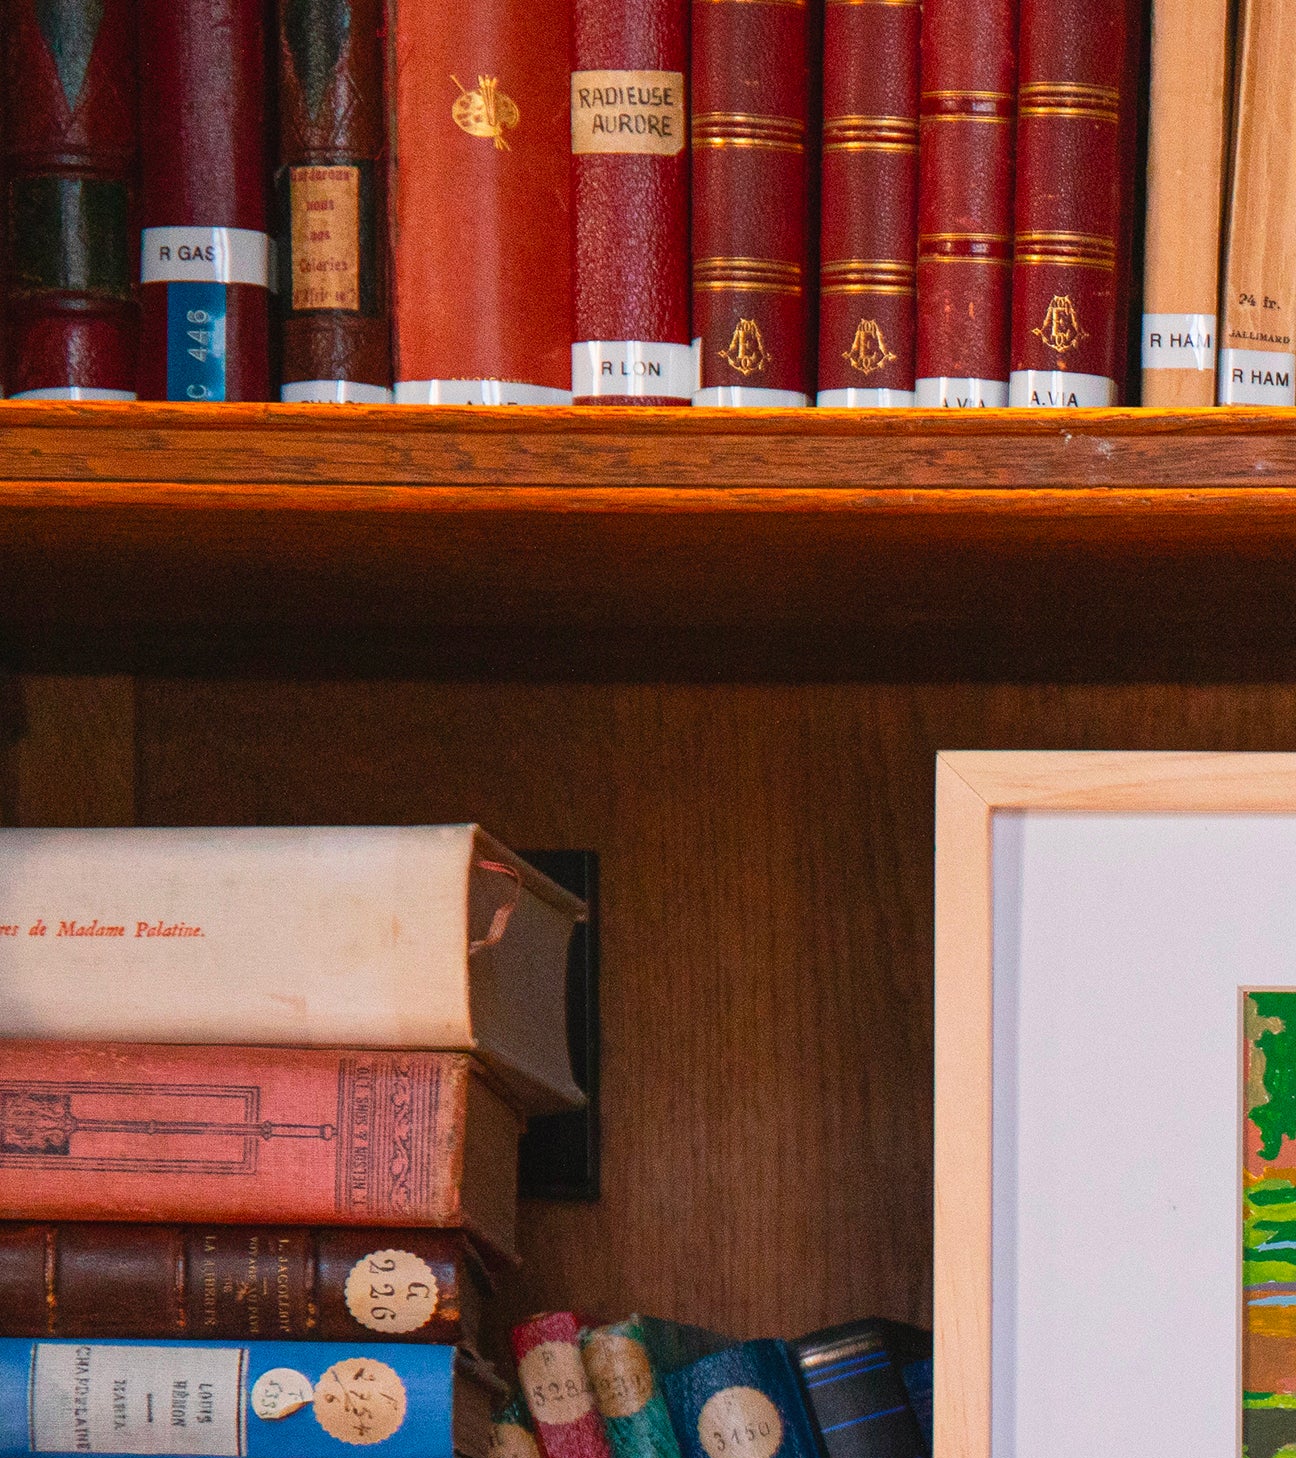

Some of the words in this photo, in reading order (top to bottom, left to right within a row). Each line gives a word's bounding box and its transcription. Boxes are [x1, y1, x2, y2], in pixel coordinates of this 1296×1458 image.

[579, 87, 674, 109] RADIEUSE
[591, 114, 673, 137] AURORE
[160, 247, 170, 260] R
[1150, 333, 1162, 348] R
[601, 362, 612, 375] R
[1232, 369, 1243, 384] R
[1251, 369, 1290, 387] HAM
[28, 919, 47, 936] de
[56, 919, 125, 937] Madame
[135, 920, 205, 937] Palatine.
